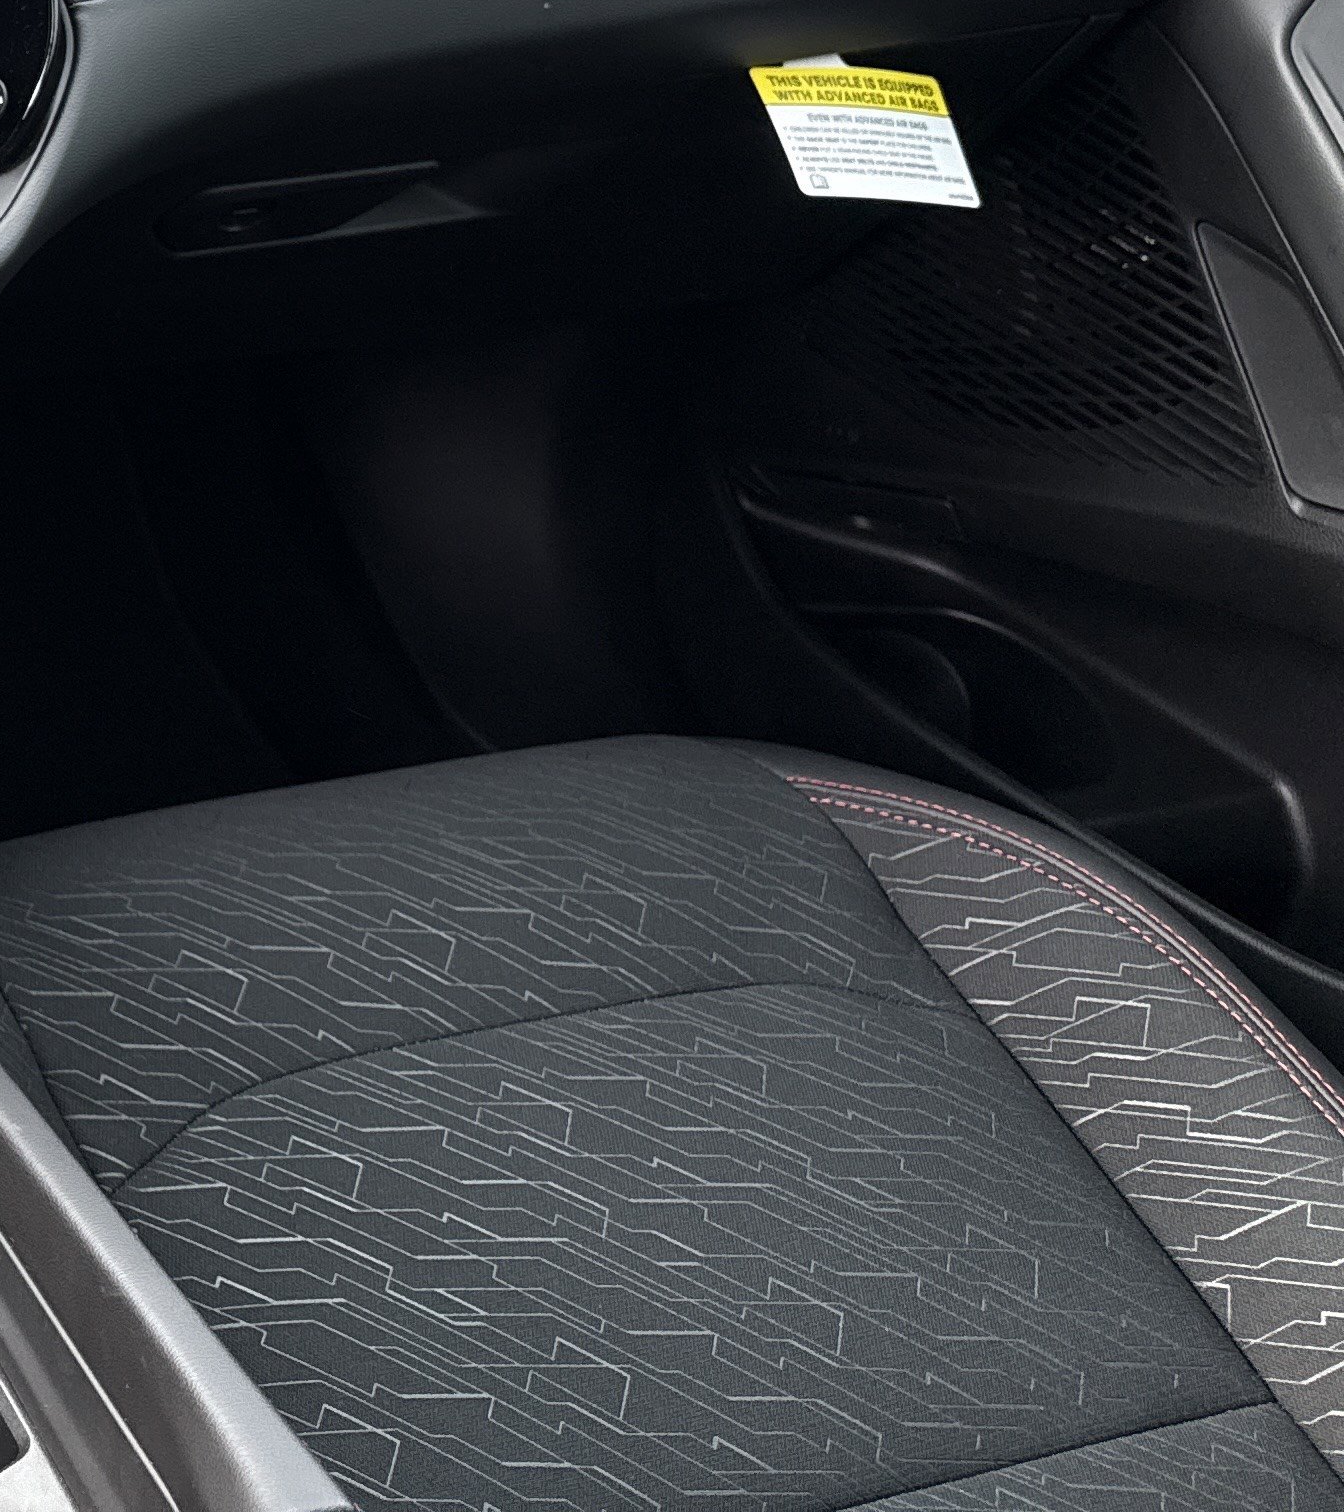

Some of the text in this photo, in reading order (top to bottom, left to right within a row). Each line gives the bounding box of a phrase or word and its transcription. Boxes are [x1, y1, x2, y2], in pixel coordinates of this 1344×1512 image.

[766, 74, 934, 97] THIS VEHICLE IS EQUIPPED
[773, 89, 939, 113] WITH ADVANCED AIR BAGS
